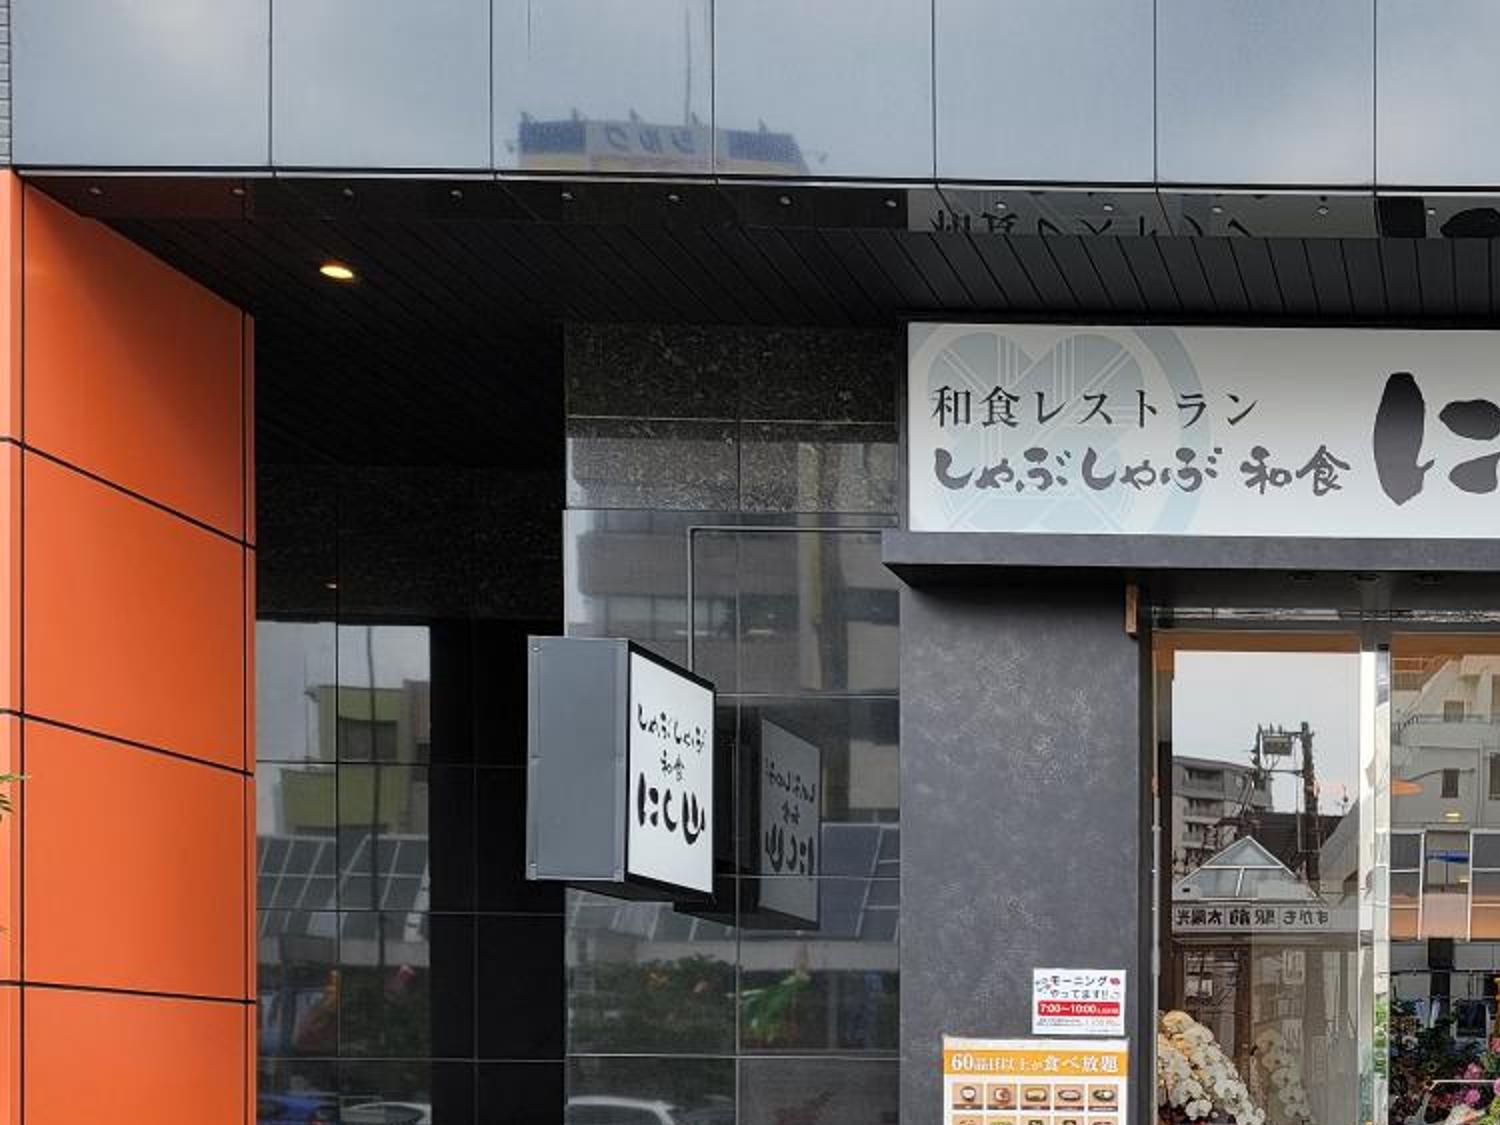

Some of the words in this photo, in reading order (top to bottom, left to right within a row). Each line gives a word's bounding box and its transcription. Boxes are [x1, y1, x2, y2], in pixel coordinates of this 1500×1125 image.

[931, 385, 1261, 429] 和食レストラン
[933, 444, 1221, 496] しゃぶしゃぶ
[1239, 445, 1350, 497] 和食
[637, 771, 706, 846] にし山
[1050, 975, 1108, 987] モーニング
